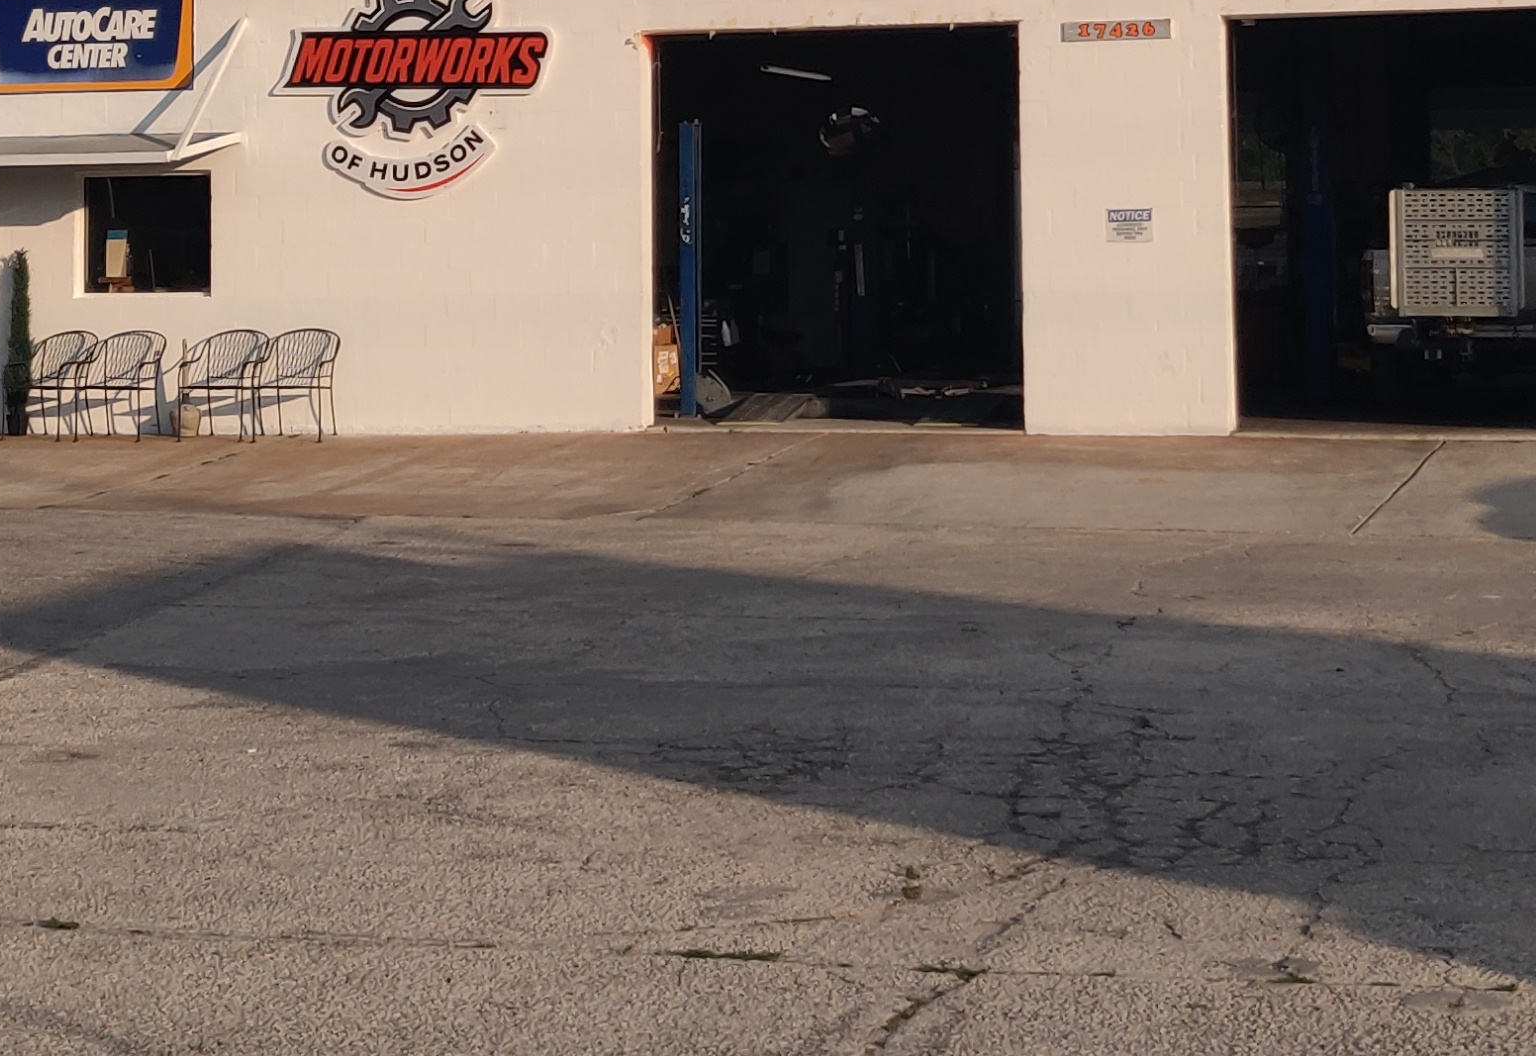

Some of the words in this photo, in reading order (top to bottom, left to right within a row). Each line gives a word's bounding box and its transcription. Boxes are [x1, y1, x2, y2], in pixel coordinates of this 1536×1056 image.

[1077, 21, 1156, 39] 17426
[46, 42, 129, 70] CENTER
[291, 36, 547, 85] MOTORWORKS
[330, 144, 363, 171] OF
[369, 129, 484, 182] HUDSON
[1109, 210, 1151, 222] NOTICE
